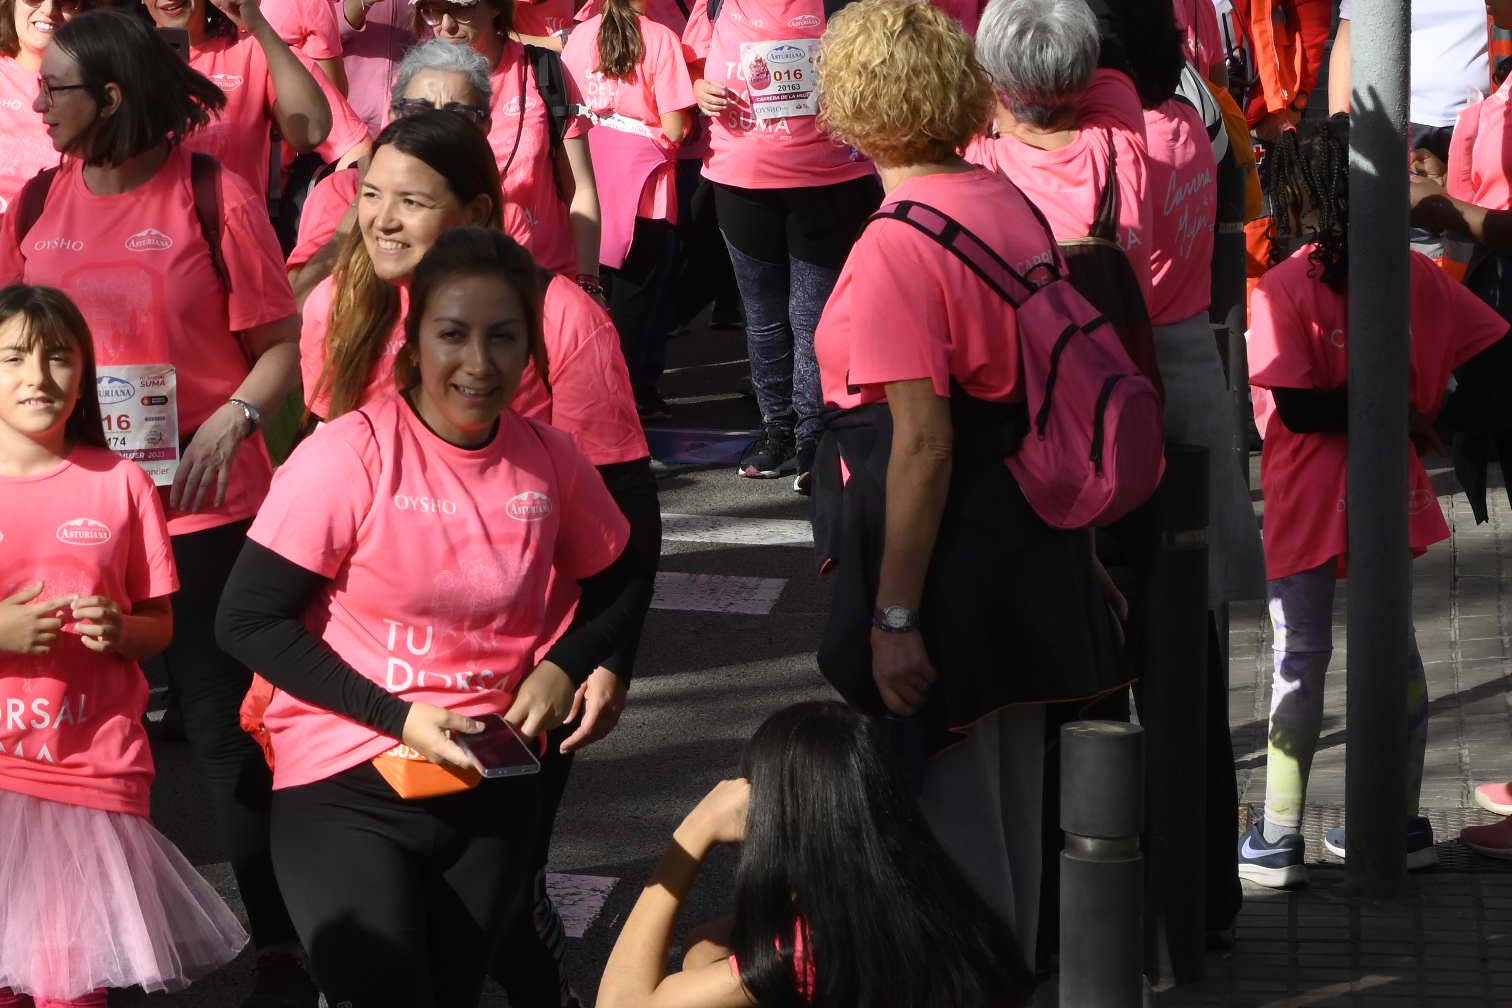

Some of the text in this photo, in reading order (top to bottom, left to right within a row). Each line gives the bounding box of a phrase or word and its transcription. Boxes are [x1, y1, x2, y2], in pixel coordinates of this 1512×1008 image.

[774, 69, 803, 81] 016
[778, 83, 801, 92] 20163
[34, 238, 85, 252] OYSHO
[140, 380, 166, 388] SUMA
[395, 494, 457, 516] OYSHO
[60, 527, 108, 541] ASTURIANA
[383, 618, 433, 656] TU
